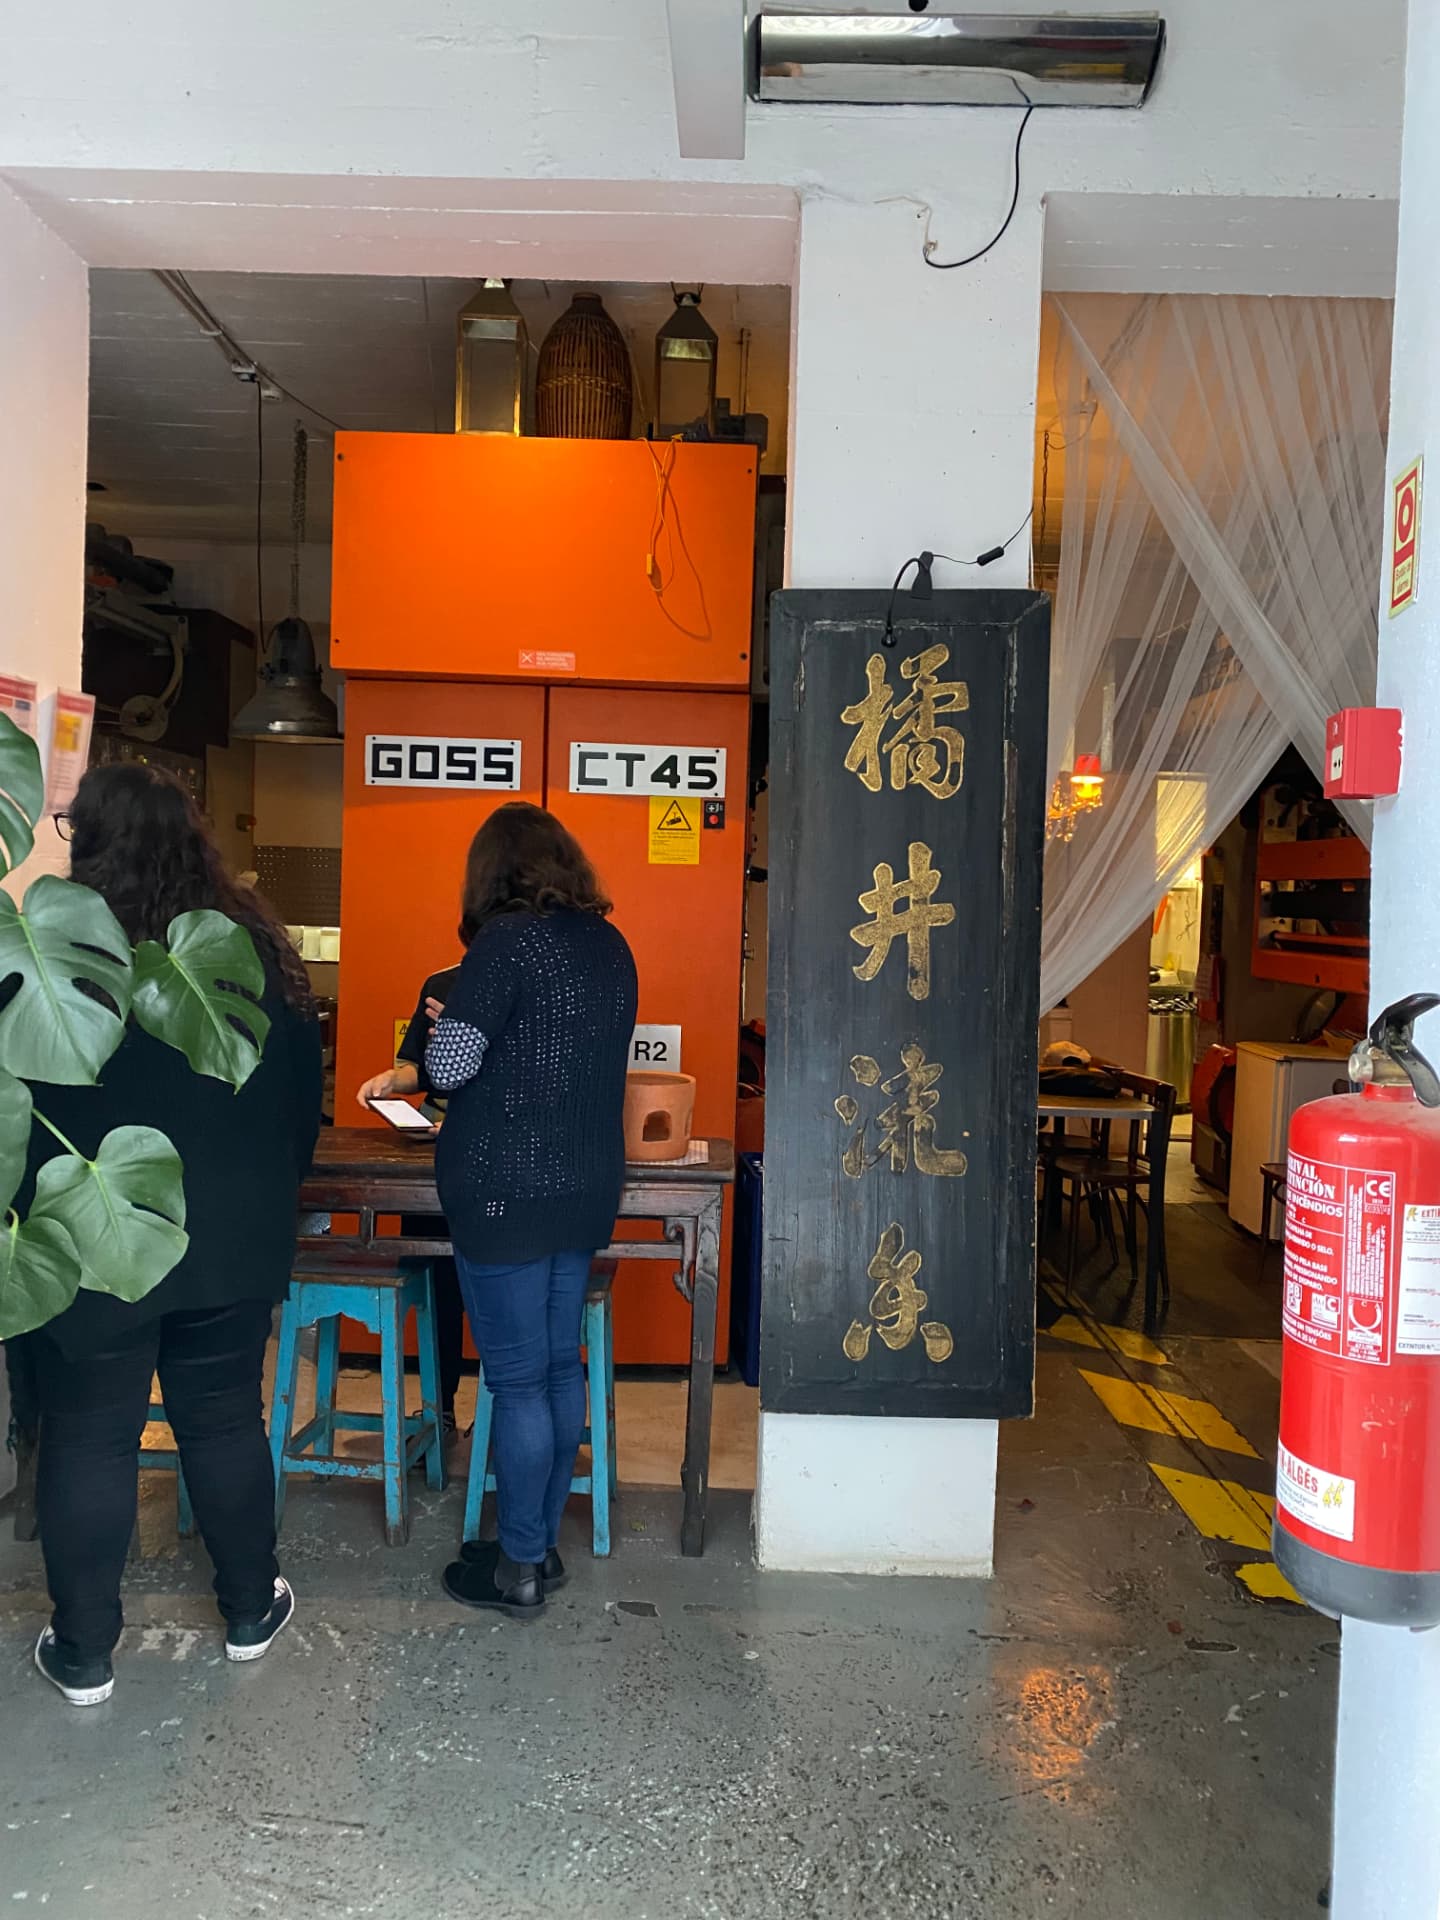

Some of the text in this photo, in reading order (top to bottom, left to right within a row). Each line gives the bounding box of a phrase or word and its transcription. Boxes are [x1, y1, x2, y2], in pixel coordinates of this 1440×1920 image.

[371, 743, 514, 783] GOSS
[577, 751, 718, 791] CT45
[634, 1040, 667, 1061] R2
[1366, 1179, 1391, 1198] CE
